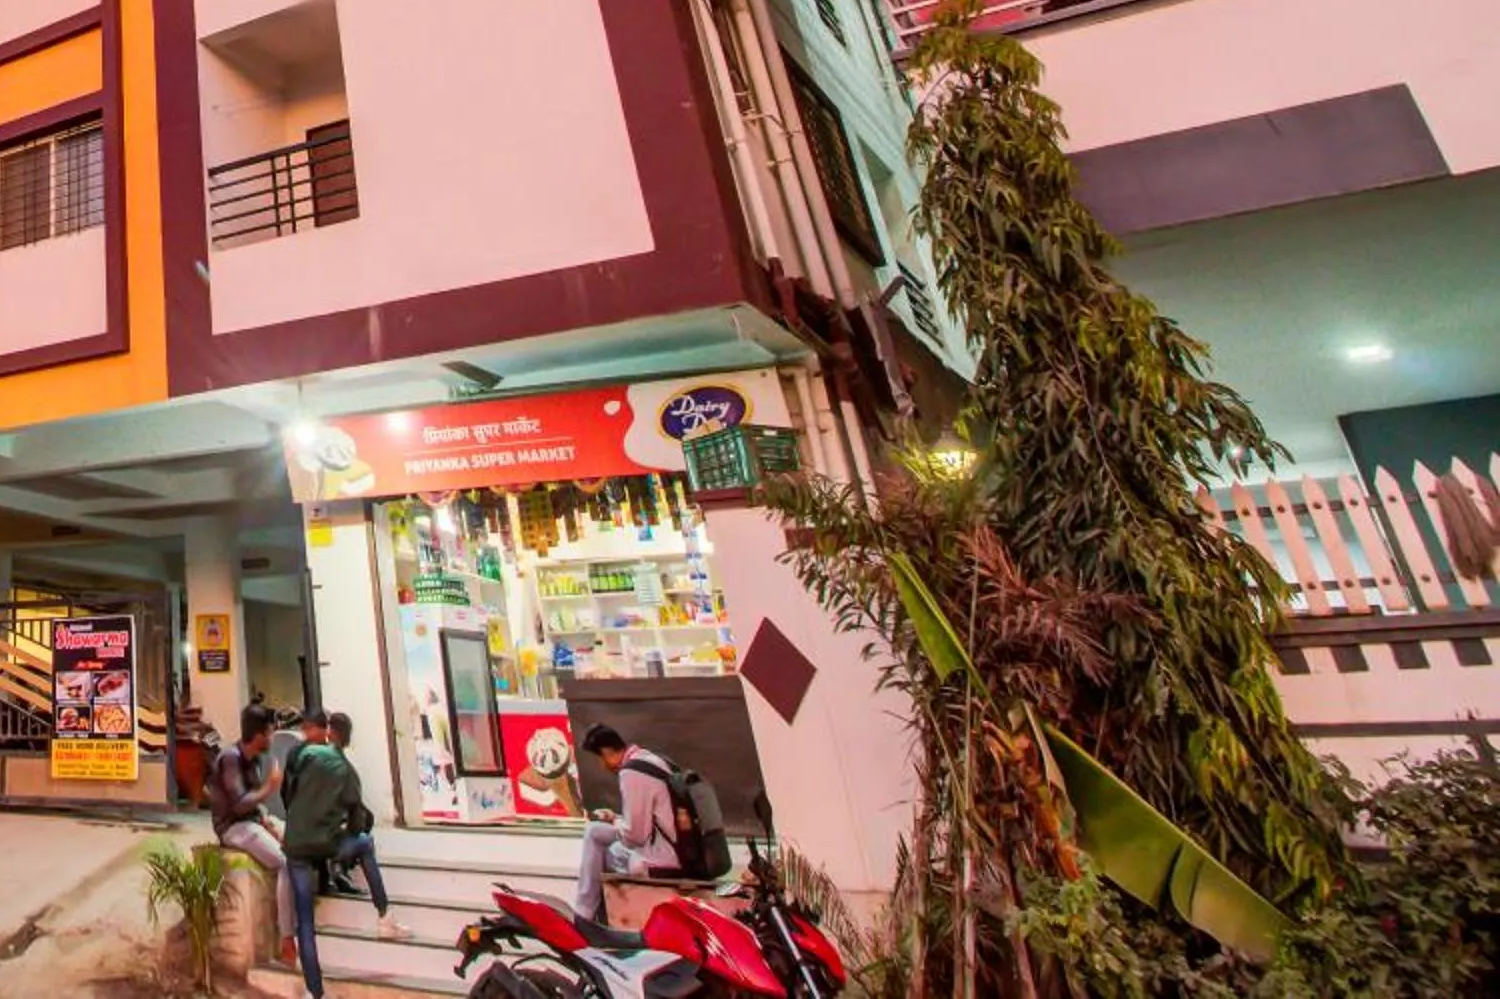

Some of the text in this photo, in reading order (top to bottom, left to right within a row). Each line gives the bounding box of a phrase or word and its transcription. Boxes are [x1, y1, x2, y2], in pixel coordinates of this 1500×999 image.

[671, 395, 731, 418] Dairy
[404, 446, 576, 476] PRIYANKA SUPER MARKET
